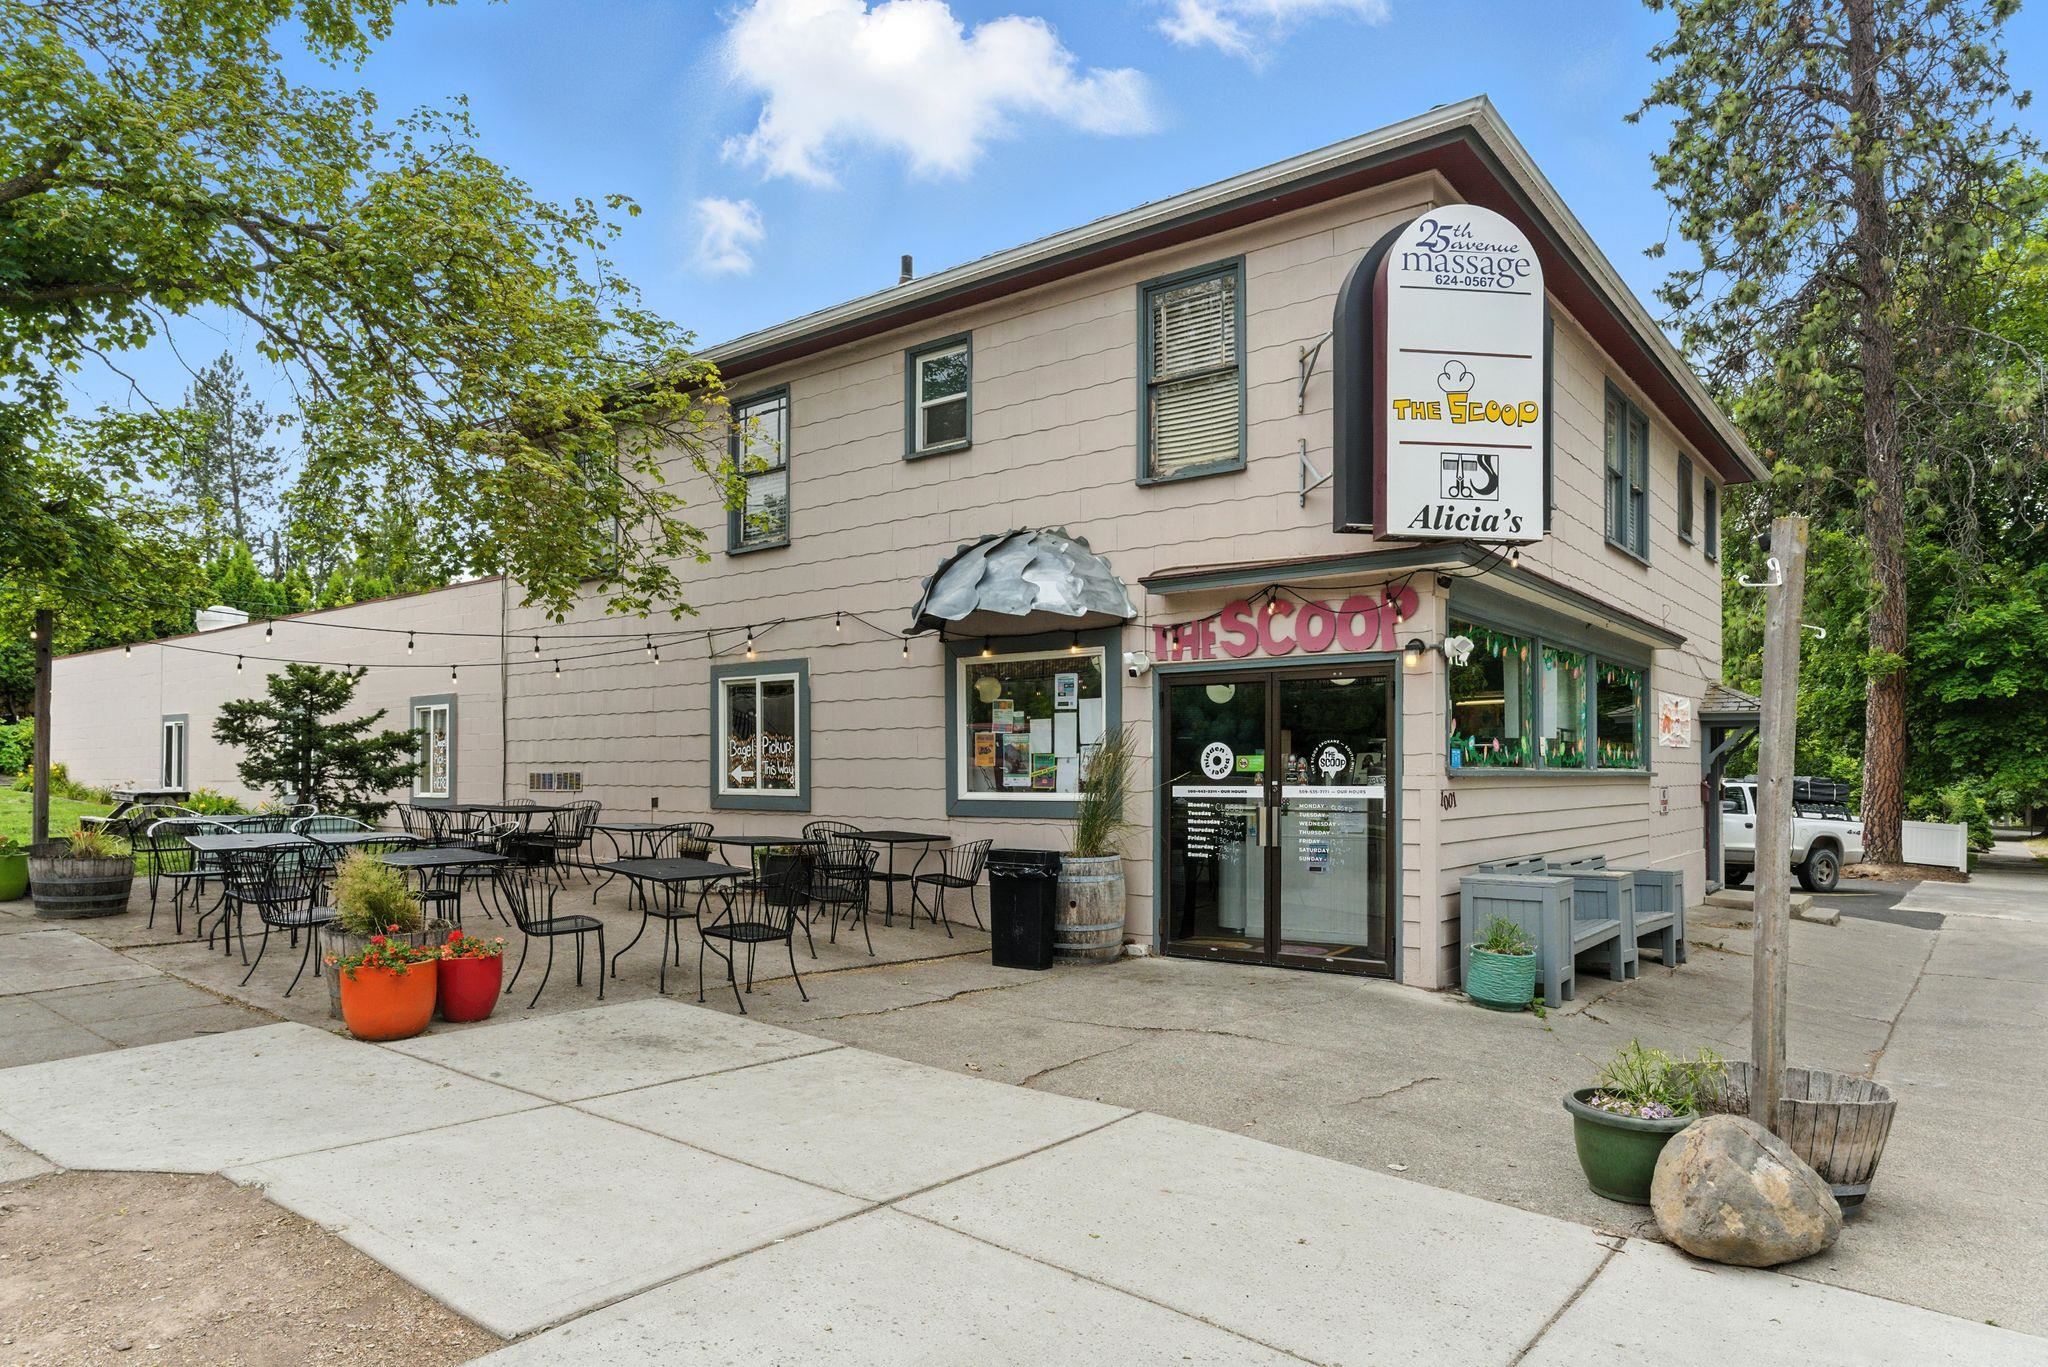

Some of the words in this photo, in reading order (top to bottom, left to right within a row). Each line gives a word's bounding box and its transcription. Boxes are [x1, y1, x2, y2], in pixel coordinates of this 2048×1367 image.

[1415, 218, 1474, 253] 25th
[1450, 240, 1520, 253] avenue
[1401, 251, 1531, 288] massage
[1435, 274, 1495, 288] 624-0567
[1393, 399, 1442, 421] THE
[1446, 392, 1539, 427] SCOOP
[1408, 504, 1524, 533] Alicia's
[1152, 618, 1218, 662] THE
[1219, 585, 1419, 658] SCOOP
[729, 739, 755, 763] Bagel
[762, 736, 791, 760] Pickup
[1203, 746, 1225, 768] hidden
[1325, 750, 1336, 758] THE
[763, 760, 777, 776] This
[777, 760, 794, 784] Way
[1211, 758, 1231, 775] bagel
[1320, 757, 1346, 768] SCOOP
[1441, 790, 1457, 811] 1001
